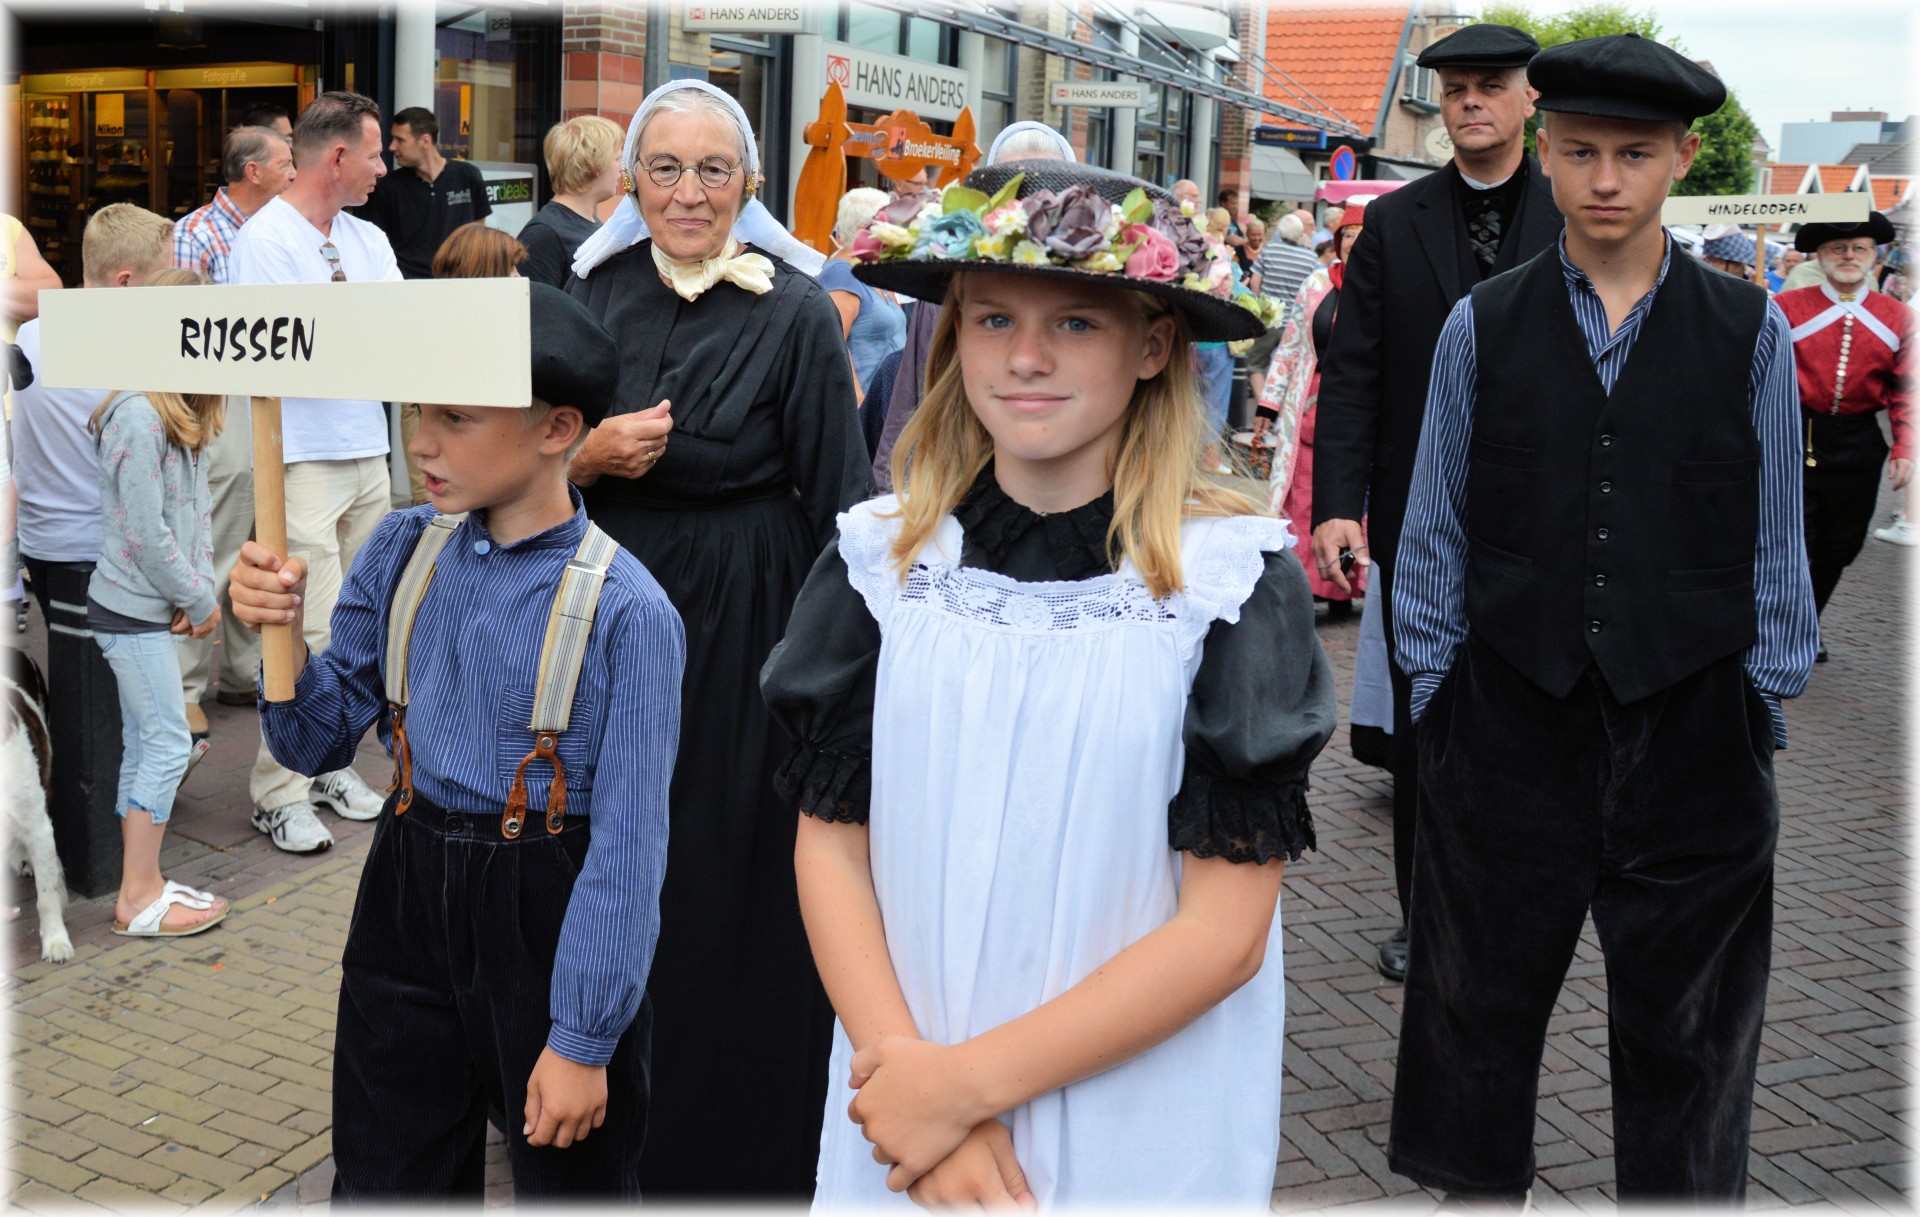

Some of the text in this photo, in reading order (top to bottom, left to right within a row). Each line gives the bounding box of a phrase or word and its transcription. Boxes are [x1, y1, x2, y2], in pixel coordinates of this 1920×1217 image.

[710, 8, 799, 21] HANS ANDERS
[65, 75, 104, 88] Fotografie
[203, 69, 247, 83] Fotografie
[857, 61, 964, 109] HANS ANDERS
[1072, 89, 1138, 100] HANS ANDERS
[96, 123, 123, 135] Nikon
[904, 139, 961, 166] BroekerVeiling
[1708, 203, 1809, 215] HINDELOOPEN
[181, 317, 315, 362] RIJSSEN
